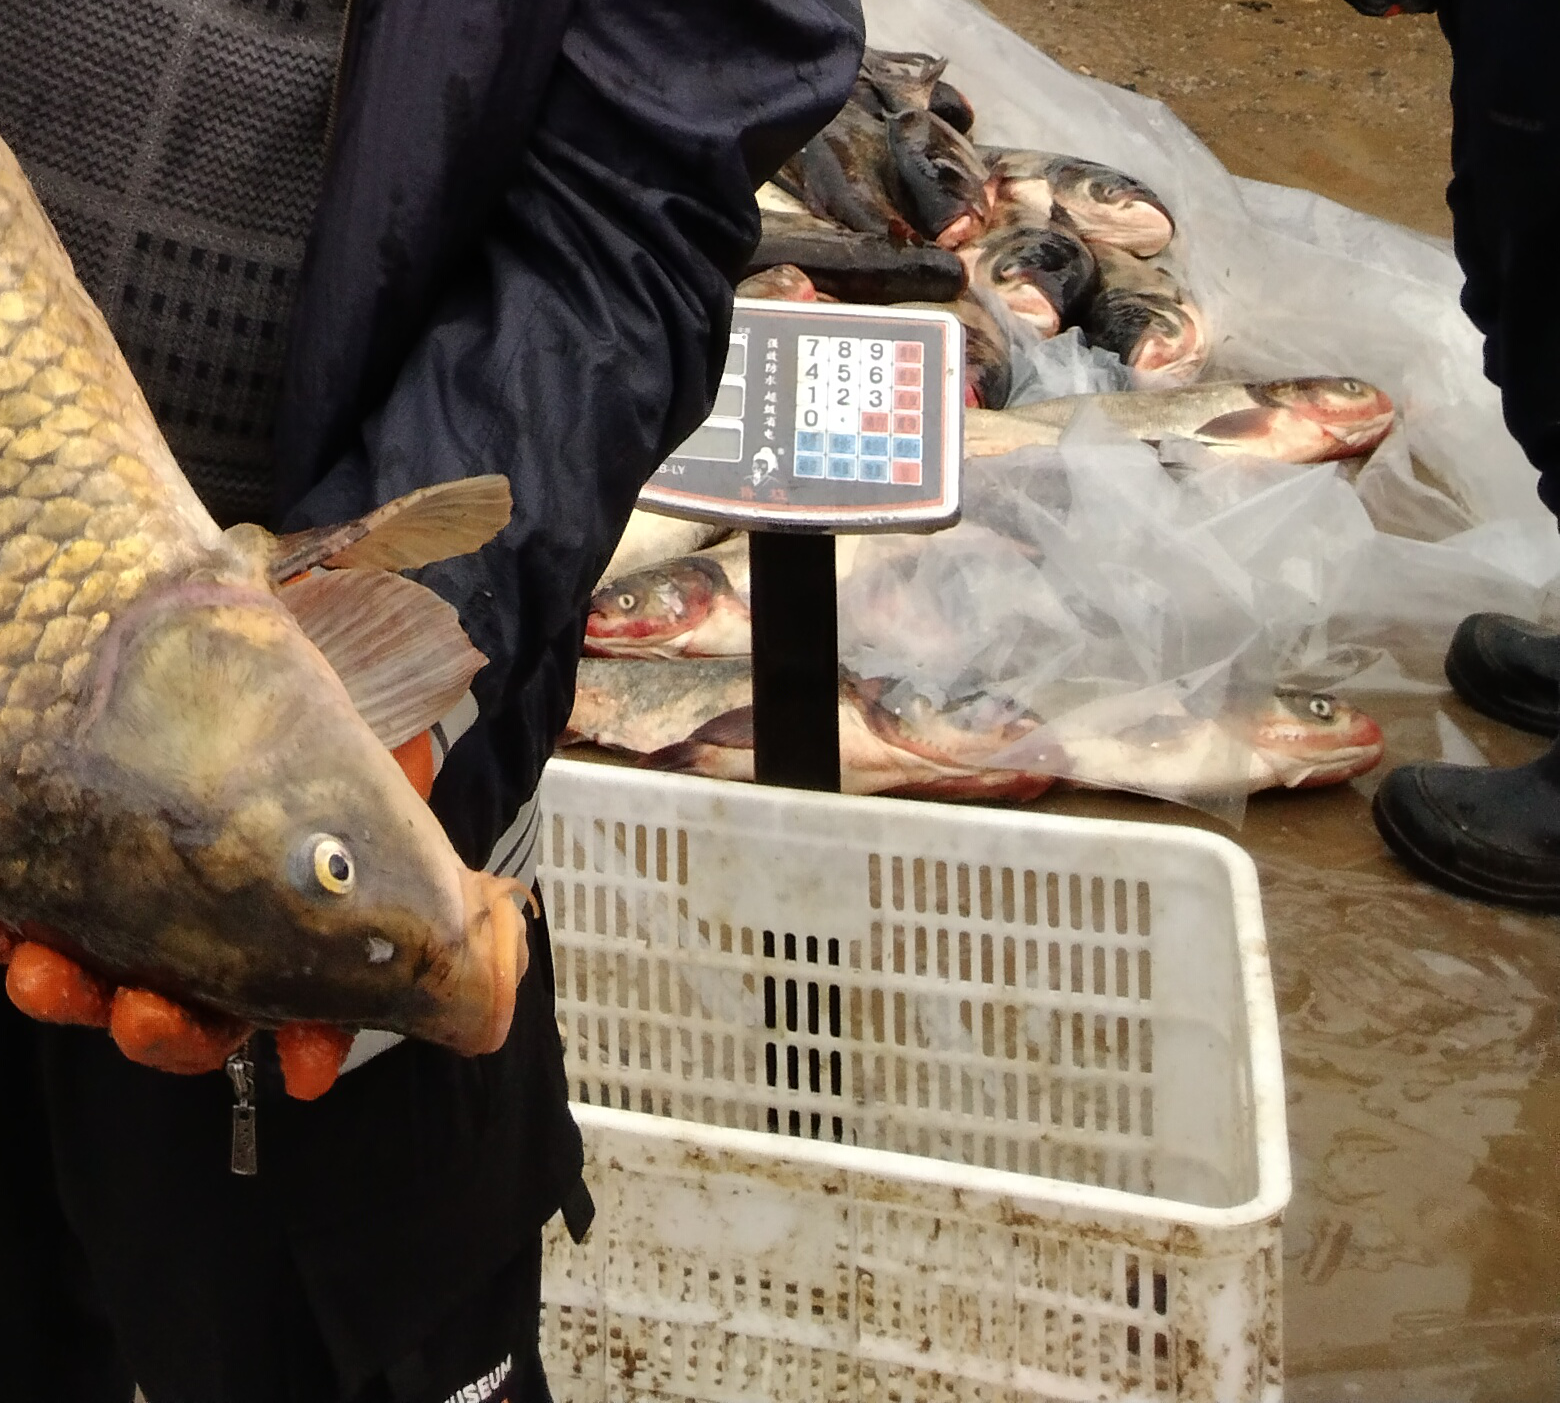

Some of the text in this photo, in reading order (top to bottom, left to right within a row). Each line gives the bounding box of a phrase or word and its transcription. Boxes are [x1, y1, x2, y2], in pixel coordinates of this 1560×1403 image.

[806, 339, 820, 357] 7
[838, 341, 852, 359] 8
[870, 343, 884, 361] 9
[805, 363, 819, 381] 4
[837, 364, 851, 383] 5
[869, 366, 883, 384] 6
[807, 386, 816, 404] 1
[837, 388, 851, 406] 2
[868, 390, 883, 408] 3
[804, 409, 819, 427] 0
